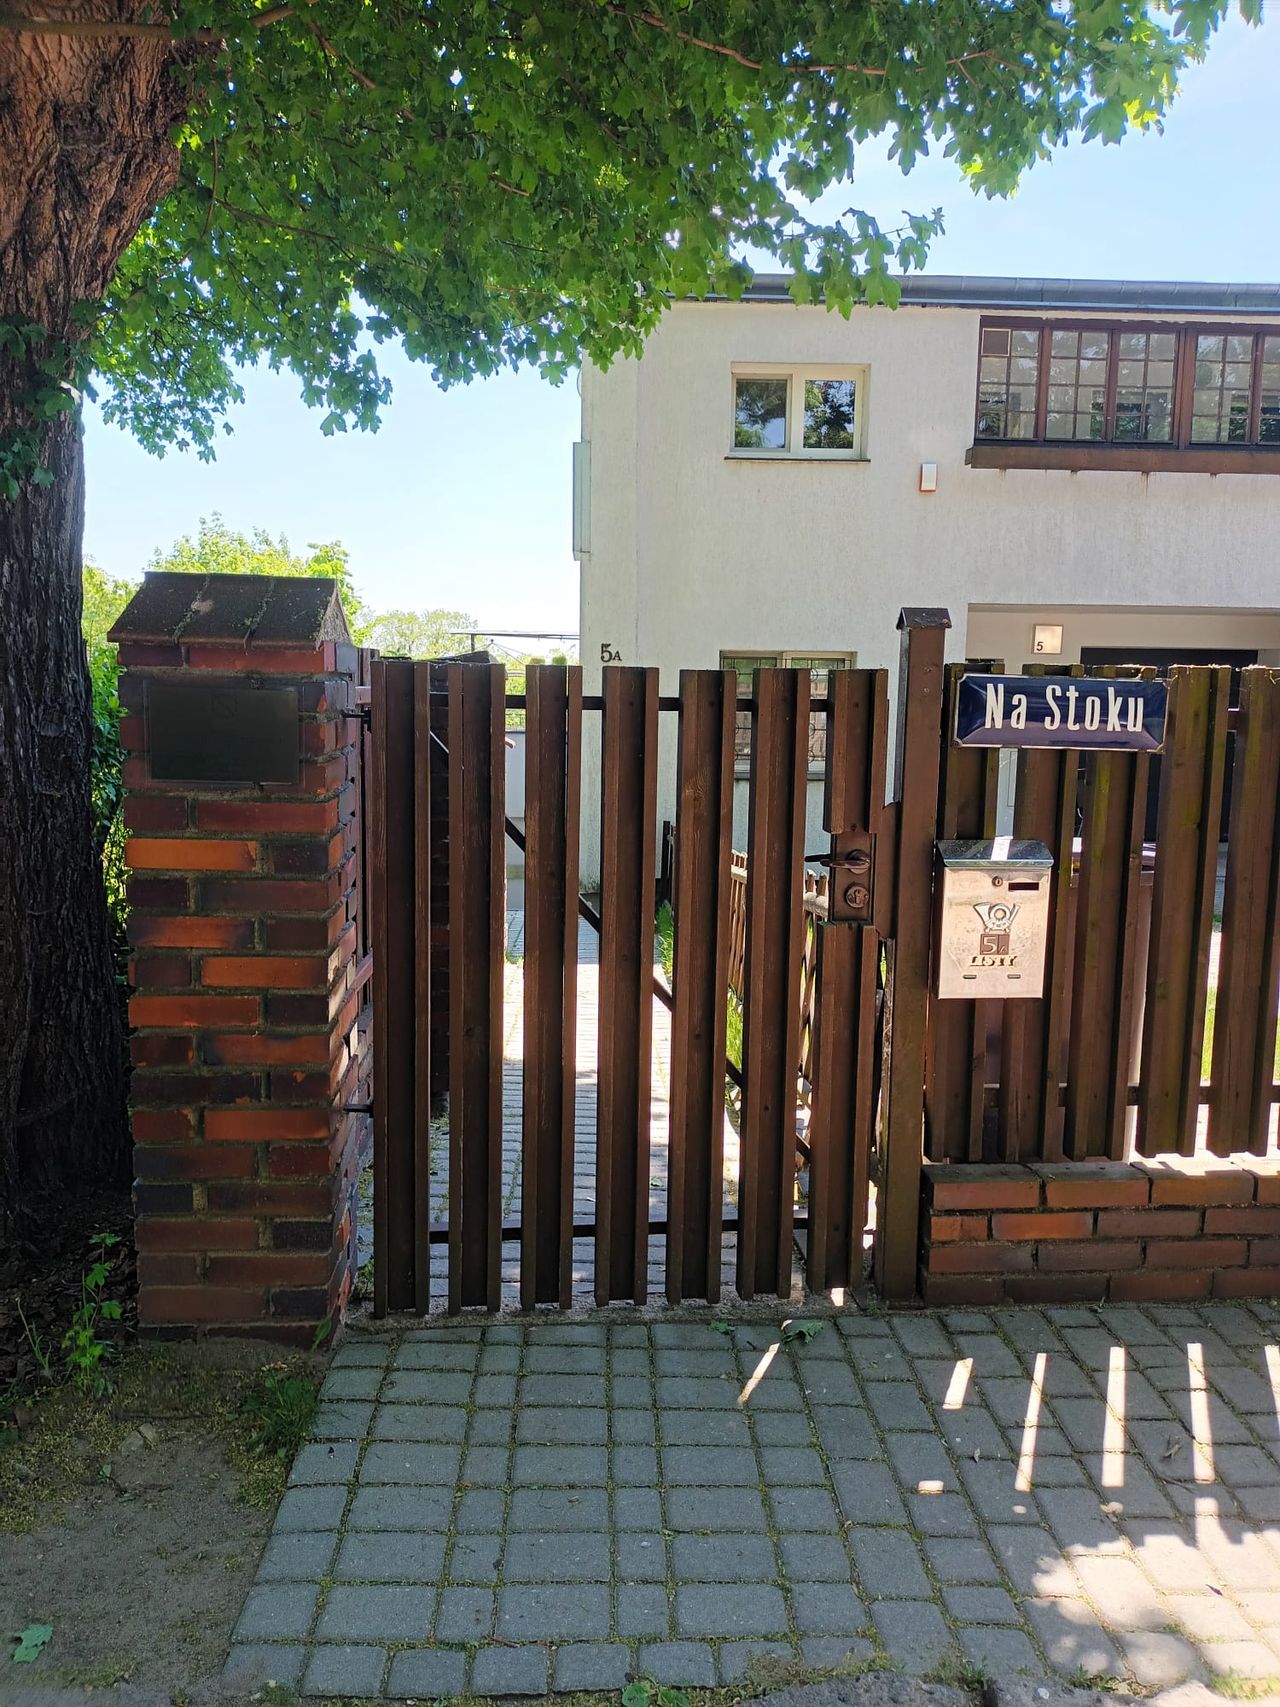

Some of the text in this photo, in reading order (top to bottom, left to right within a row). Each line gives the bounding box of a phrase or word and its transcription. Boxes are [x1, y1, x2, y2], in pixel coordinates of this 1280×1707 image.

[600, 643, 622, 662] 5A
[1036, 641, 1044, 652] 5
[984, 683, 1144, 732] Na Stoku
[969, 955, 1017, 966] LISTY
